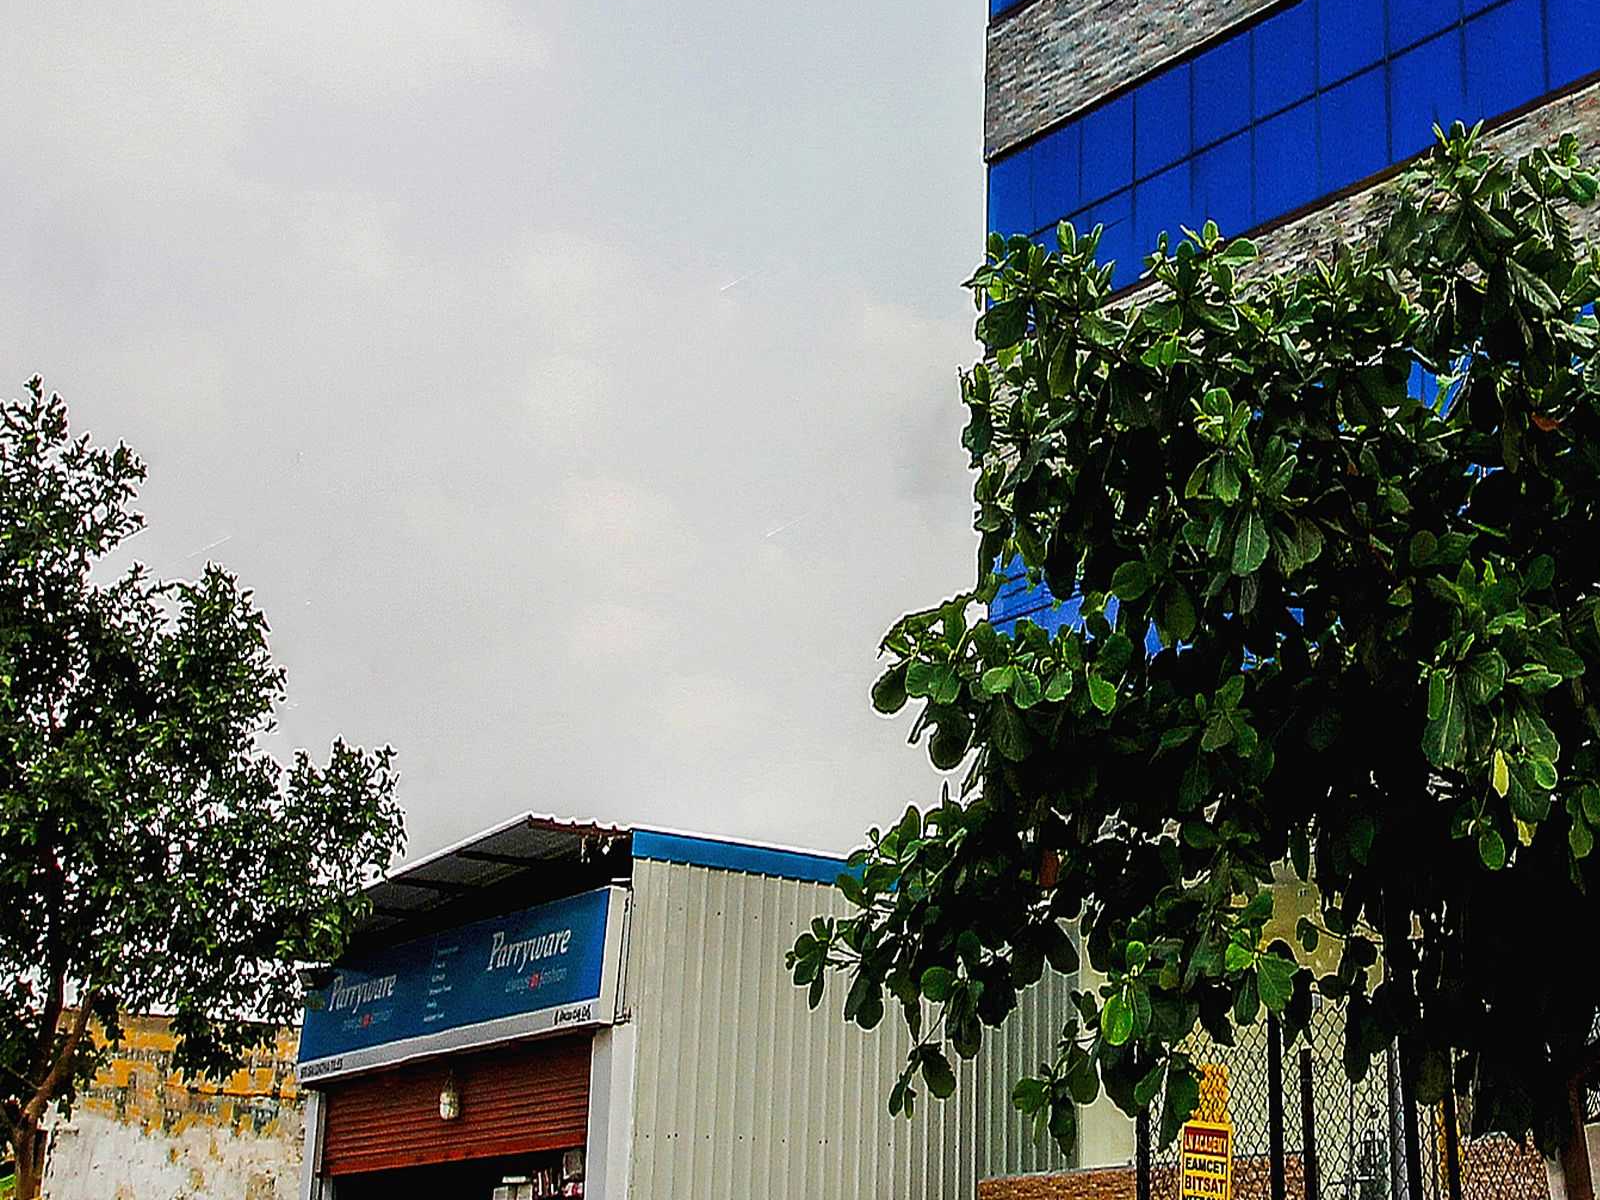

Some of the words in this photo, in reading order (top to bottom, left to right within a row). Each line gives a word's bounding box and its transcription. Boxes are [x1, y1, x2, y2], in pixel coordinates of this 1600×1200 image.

[487, 928, 571, 974] Parryware
[327, 973, 398, 1014] Parryware
[1185, 1156, 1226, 1175] EAMCET
[1185, 1174, 1226, 1194] BITSAT
